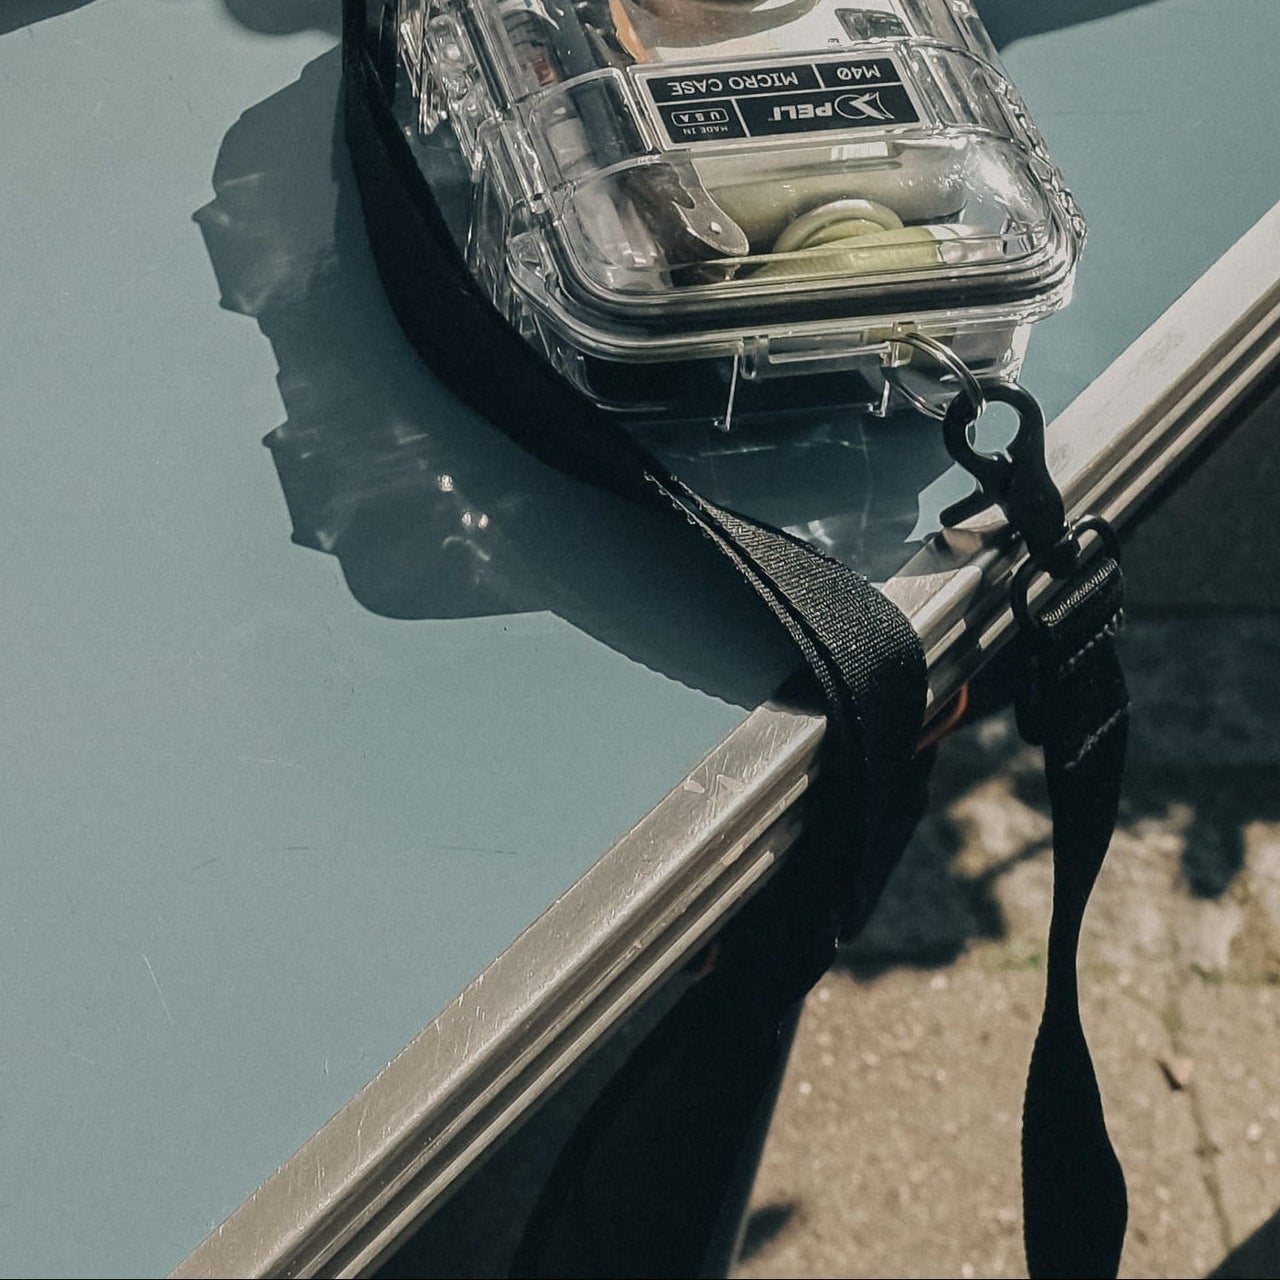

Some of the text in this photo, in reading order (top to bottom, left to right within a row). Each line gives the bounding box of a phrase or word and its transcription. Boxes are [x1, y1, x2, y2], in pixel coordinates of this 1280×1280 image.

[837, 64, 881, 81] M40
[668, 71, 799, 97] MICRO CASE
[773, 102, 833, 120] PELI
[682, 125, 728, 135] MADE IN
